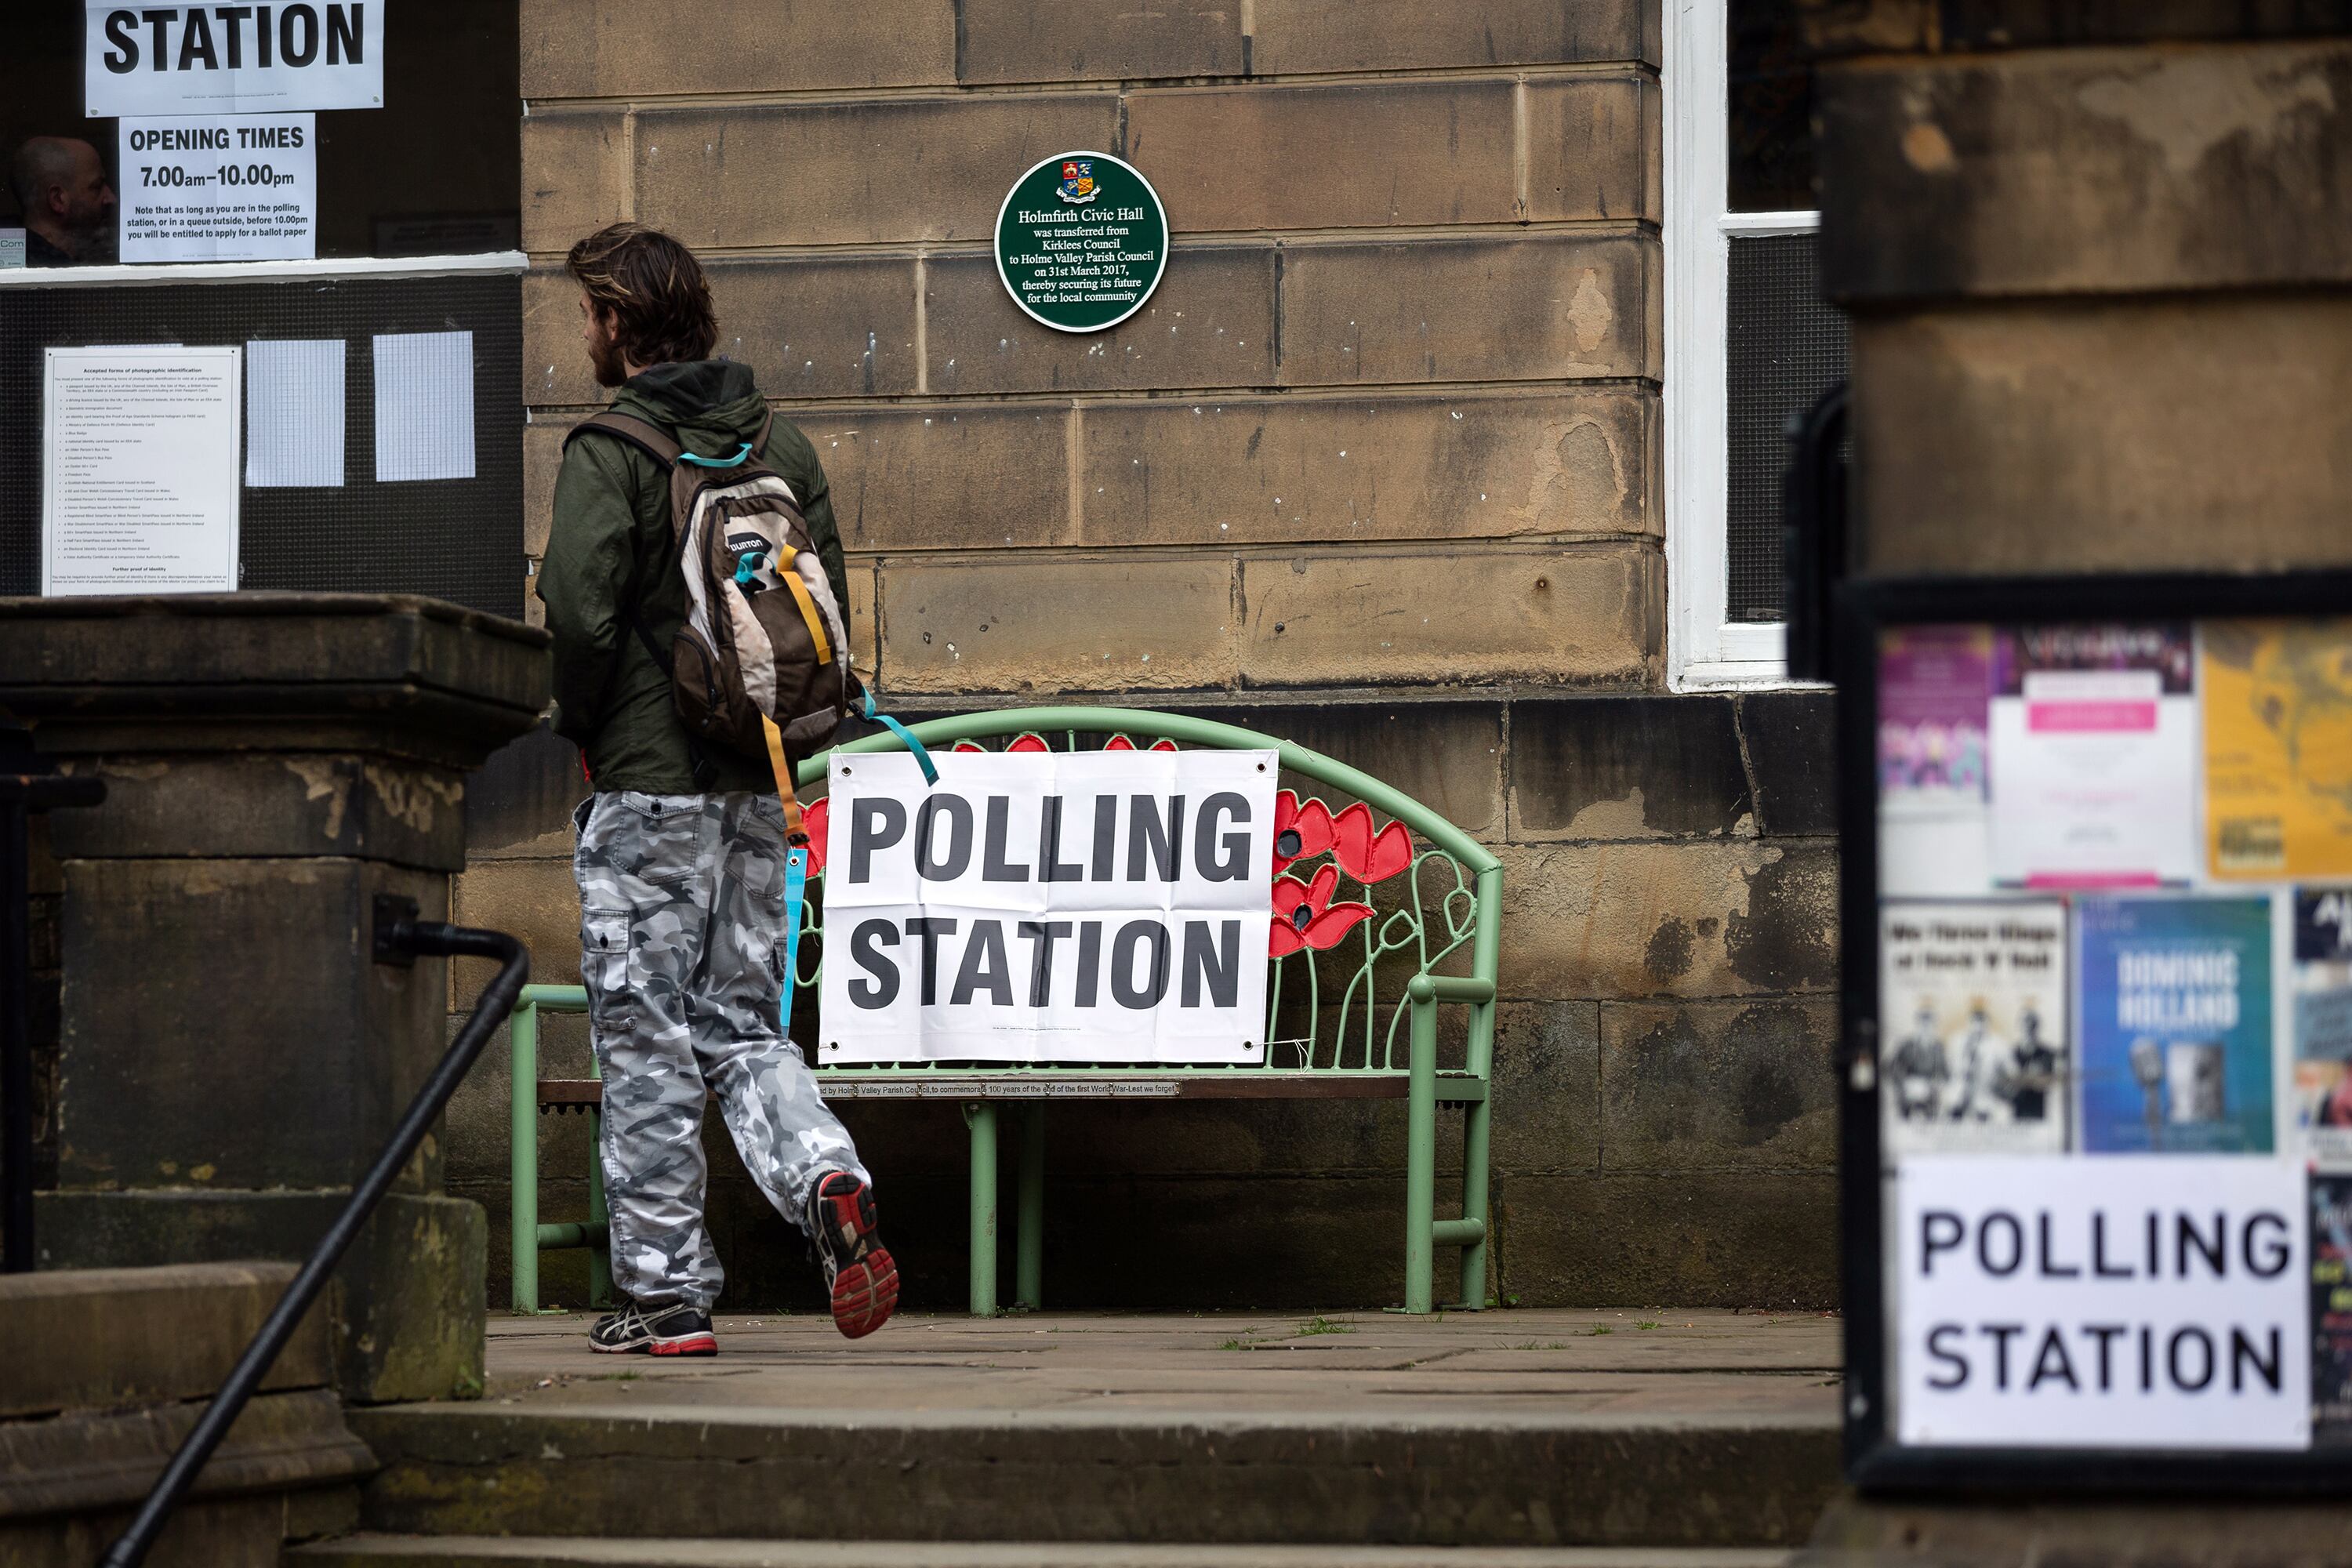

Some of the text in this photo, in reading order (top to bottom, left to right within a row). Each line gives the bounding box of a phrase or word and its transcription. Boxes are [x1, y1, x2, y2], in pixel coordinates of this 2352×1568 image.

[103, 2, 363, 74] STATION
[129, 126, 303, 151] OPENING TIMES
[186, 205, 203, 216] long
[216, 206, 230, 215] you
[273, 203, 299, 213] polling
[1018, 207, 1143, 223] Holmfirth Civic Hall
[127, 218, 156, 227] station,
[169, 217, 176, 226] in
[187, 219, 211, 227] queue
[212, 216, 244, 225] outside,
[246, 216, 271, 224] before
[274, 215, 307, 225] 10.00pm
[128, 232, 142, 241] you
[143, 230, 158, 238] will
[172, 229, 203, 238] entitled
[205, 229, 213, 238] to
[215, 228, 237, 238] apply
[238, 228, 249, 237] for
[259, 227, 281, 236] ballot
[284, 229, 307, 238] paper
[1054, 225, 1104, 237] transferred
[1106, 225, 1129, 235] from
[1042, 238, 1120, 250] Kirklees Council
[1009, 250, 1153, 264] to Holme Valley Parish Council
[1048, 266, 1068, 276] 31st
[1070, 265, 1100, 275] March
[1102, 264, 1129, 276] 2017,
[1022, 278, 1142, 292] thereby securing its future
[1027, 290, 1138, 303] for the local community
[848, 791, 1251, 884] POLLING
[848, 916, 1240, 1010] STATION
[828, 1087, 837, 1095] by
[861, 1086, 881, 1095] Valley
[940, 1085, 987, 1094] commemorate
[1003, 1086, 1021, 1094] years
[1155, 1084, 1174, 1094] forget
[1922, 1211, 2291, 1279] POLLING
[1927, 1325, 2282, 1394] STATION
